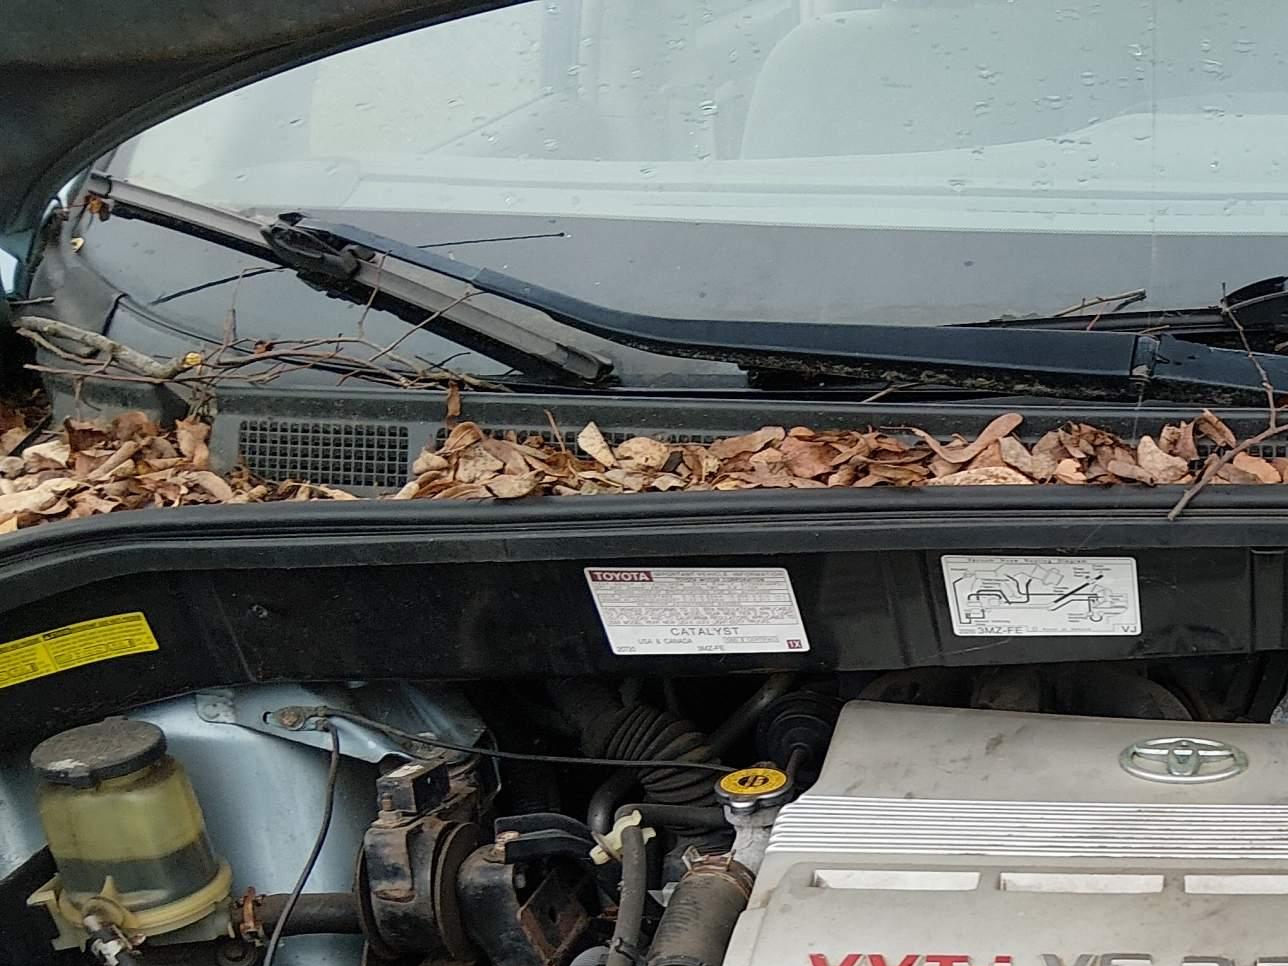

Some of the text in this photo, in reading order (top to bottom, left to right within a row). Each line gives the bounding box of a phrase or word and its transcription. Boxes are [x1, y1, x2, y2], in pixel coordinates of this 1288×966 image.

[592, 572, 651, 582] TOYOTA
[670, 626, 741, 637] CATALYST
[976, 626, 1025, 635] 3MZ-FE
[1121, 625, 1138, 634] VJ
